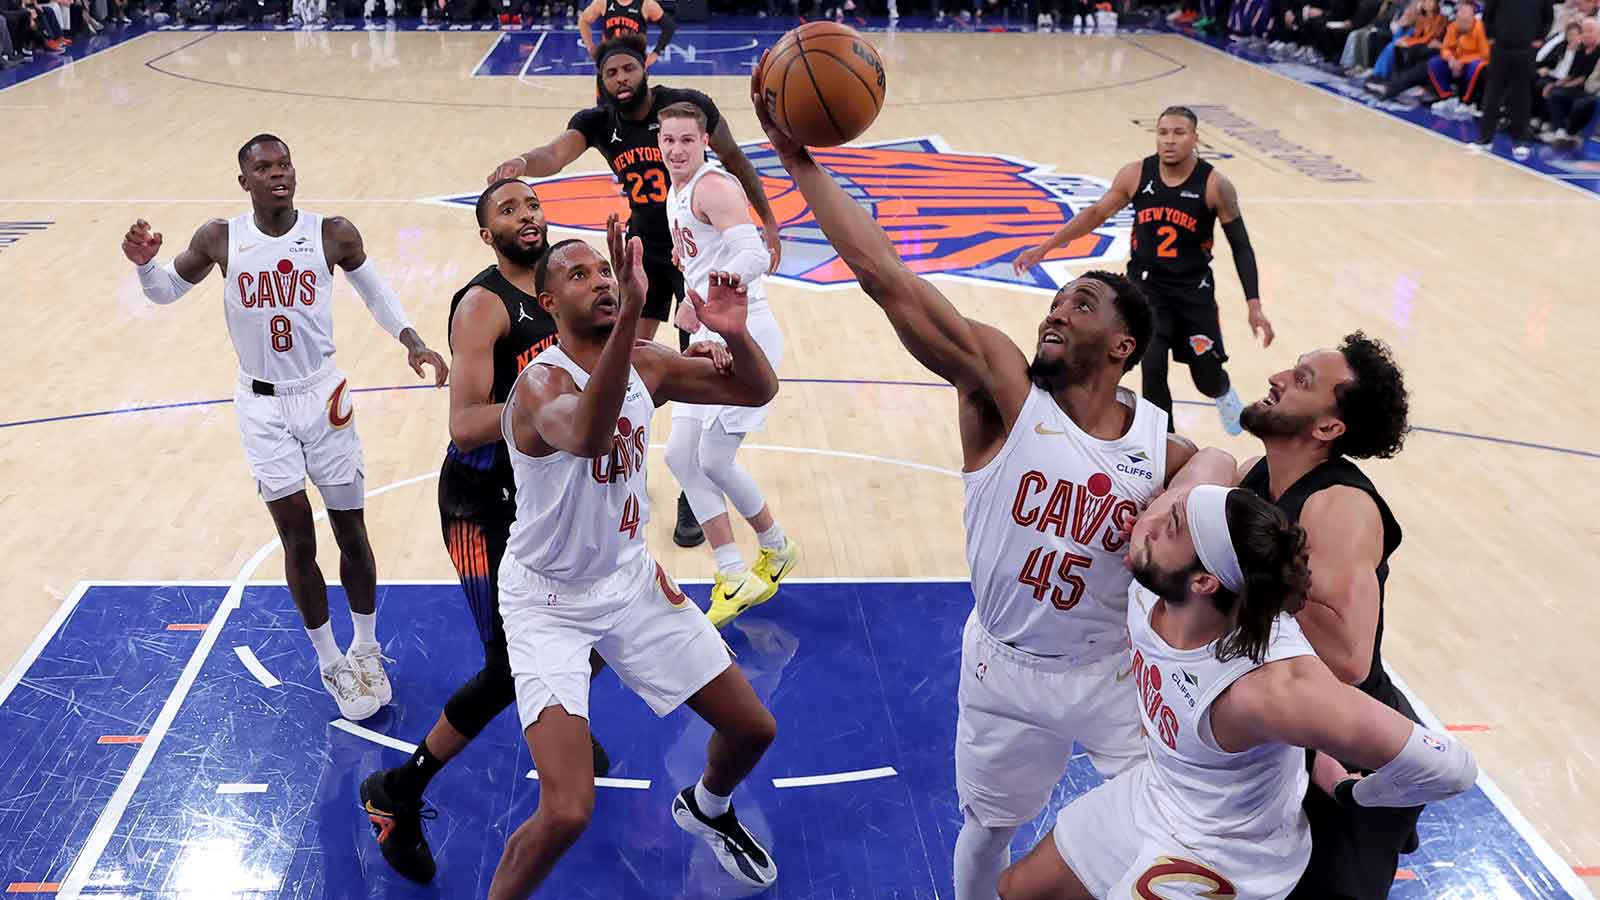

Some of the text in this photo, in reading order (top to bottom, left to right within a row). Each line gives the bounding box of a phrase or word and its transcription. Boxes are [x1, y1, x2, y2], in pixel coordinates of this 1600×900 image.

[637, 146, 664, 163] YOR
[625, 167, 667, 204] 23
[1138, 207, 1163, 224] NEW
[1164, 207, 1198, 232] YORK
[1156, 225, 1178, 258] 2
[238, 267, 317, 309] CAVS
[270, 315, 293, 353] 8
[1116, 463, 1153, 480] CLIFFS
[619, 492, 641, 540] 4
[1011, 469, 1138, 552] CAVS
[1018, 546, 1093, 611] 45
[1171, 672, 1196, 709] CLIFFS
